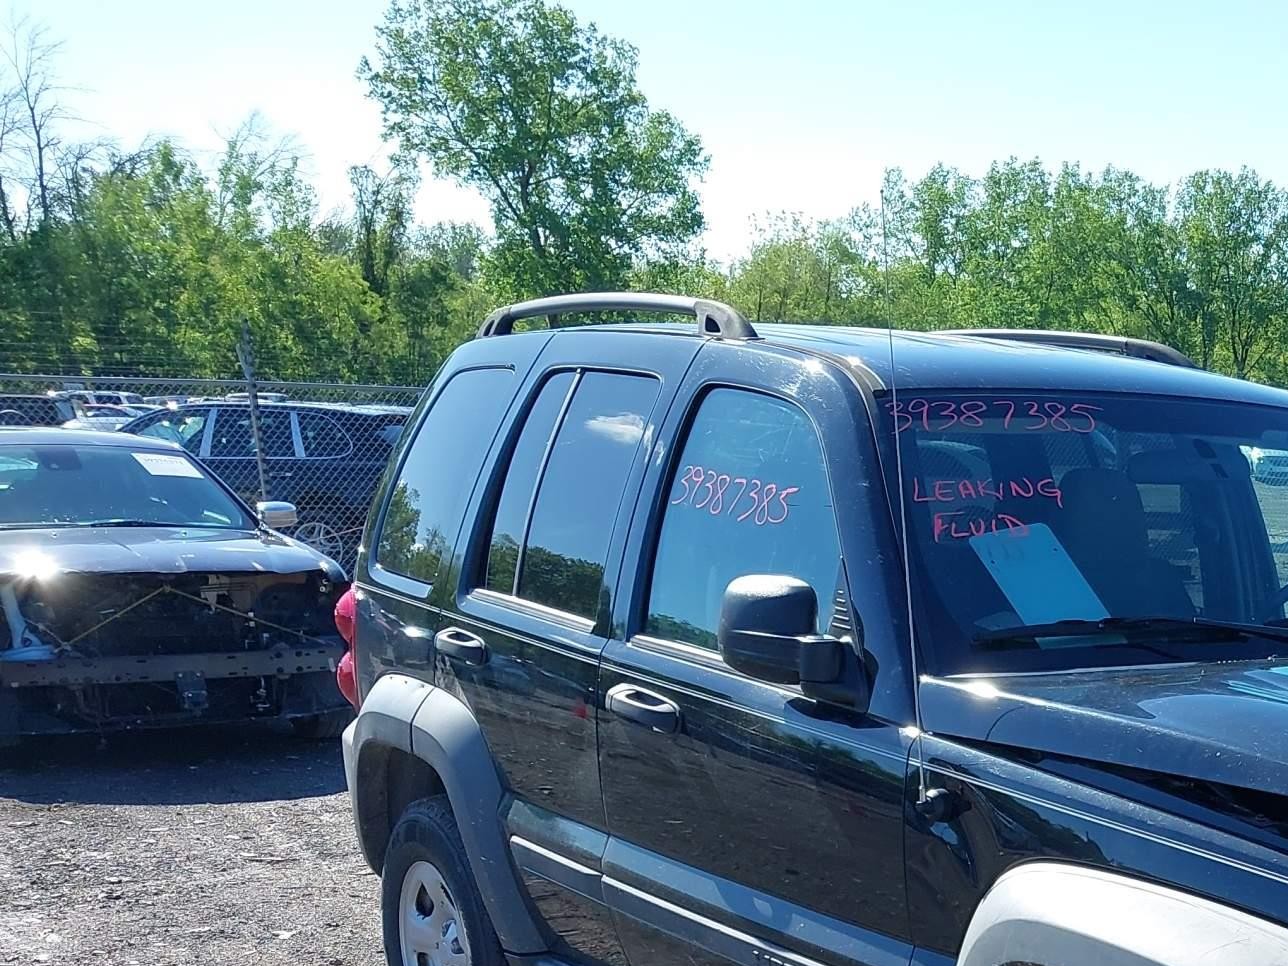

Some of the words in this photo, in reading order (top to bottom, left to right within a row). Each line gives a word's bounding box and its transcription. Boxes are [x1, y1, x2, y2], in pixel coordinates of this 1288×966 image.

[884, 398, 1103, 435] 39387385
[671, 465, 801, 526] 39387385
[912, 476, 1064, 509] LEAKING
[933, 511, 1030, 544] FLUID
